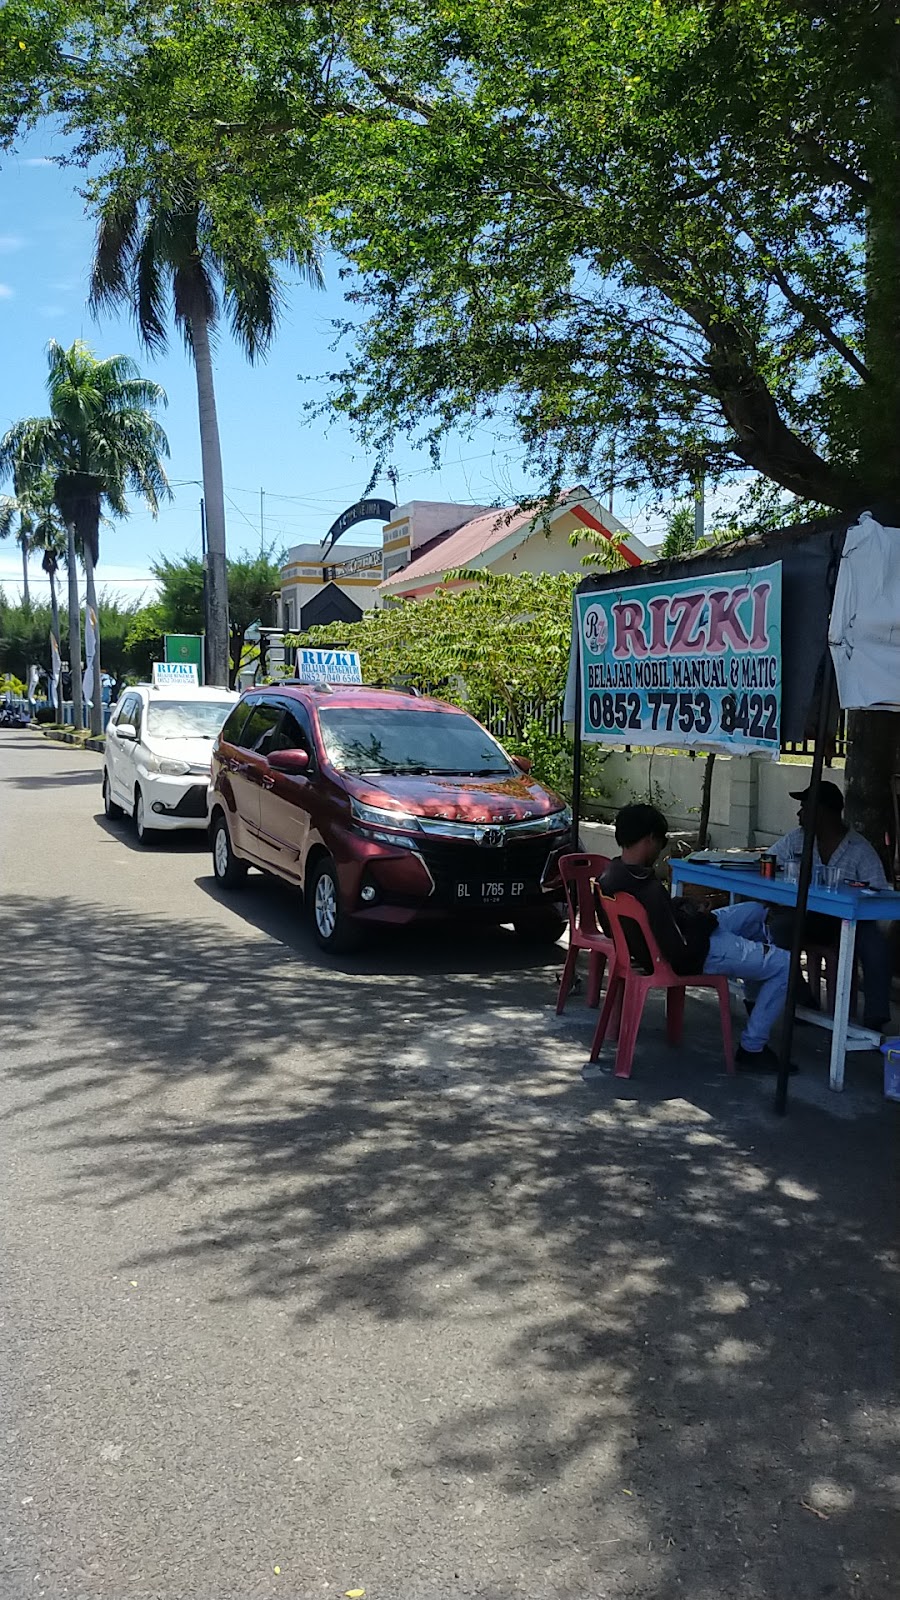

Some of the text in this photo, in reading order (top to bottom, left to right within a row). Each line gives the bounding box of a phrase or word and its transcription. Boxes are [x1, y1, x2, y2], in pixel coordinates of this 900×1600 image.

[614, 583, 770, 657] RIZKI
[302, 651, 356, 666] RIZKI
[157, 664, 193, 674] RIZKI
[301, 664, 326, 673] BELAJAR
[588, 657, 776, 688] BELAJAR MOBIL MANUAL & MATIC
[302, 672, 361, 683] 0852 7040 6568
[589, 692, 778, 740] 0852 7753 8422
[457, 882, 525, 897] BL 1765 EP
